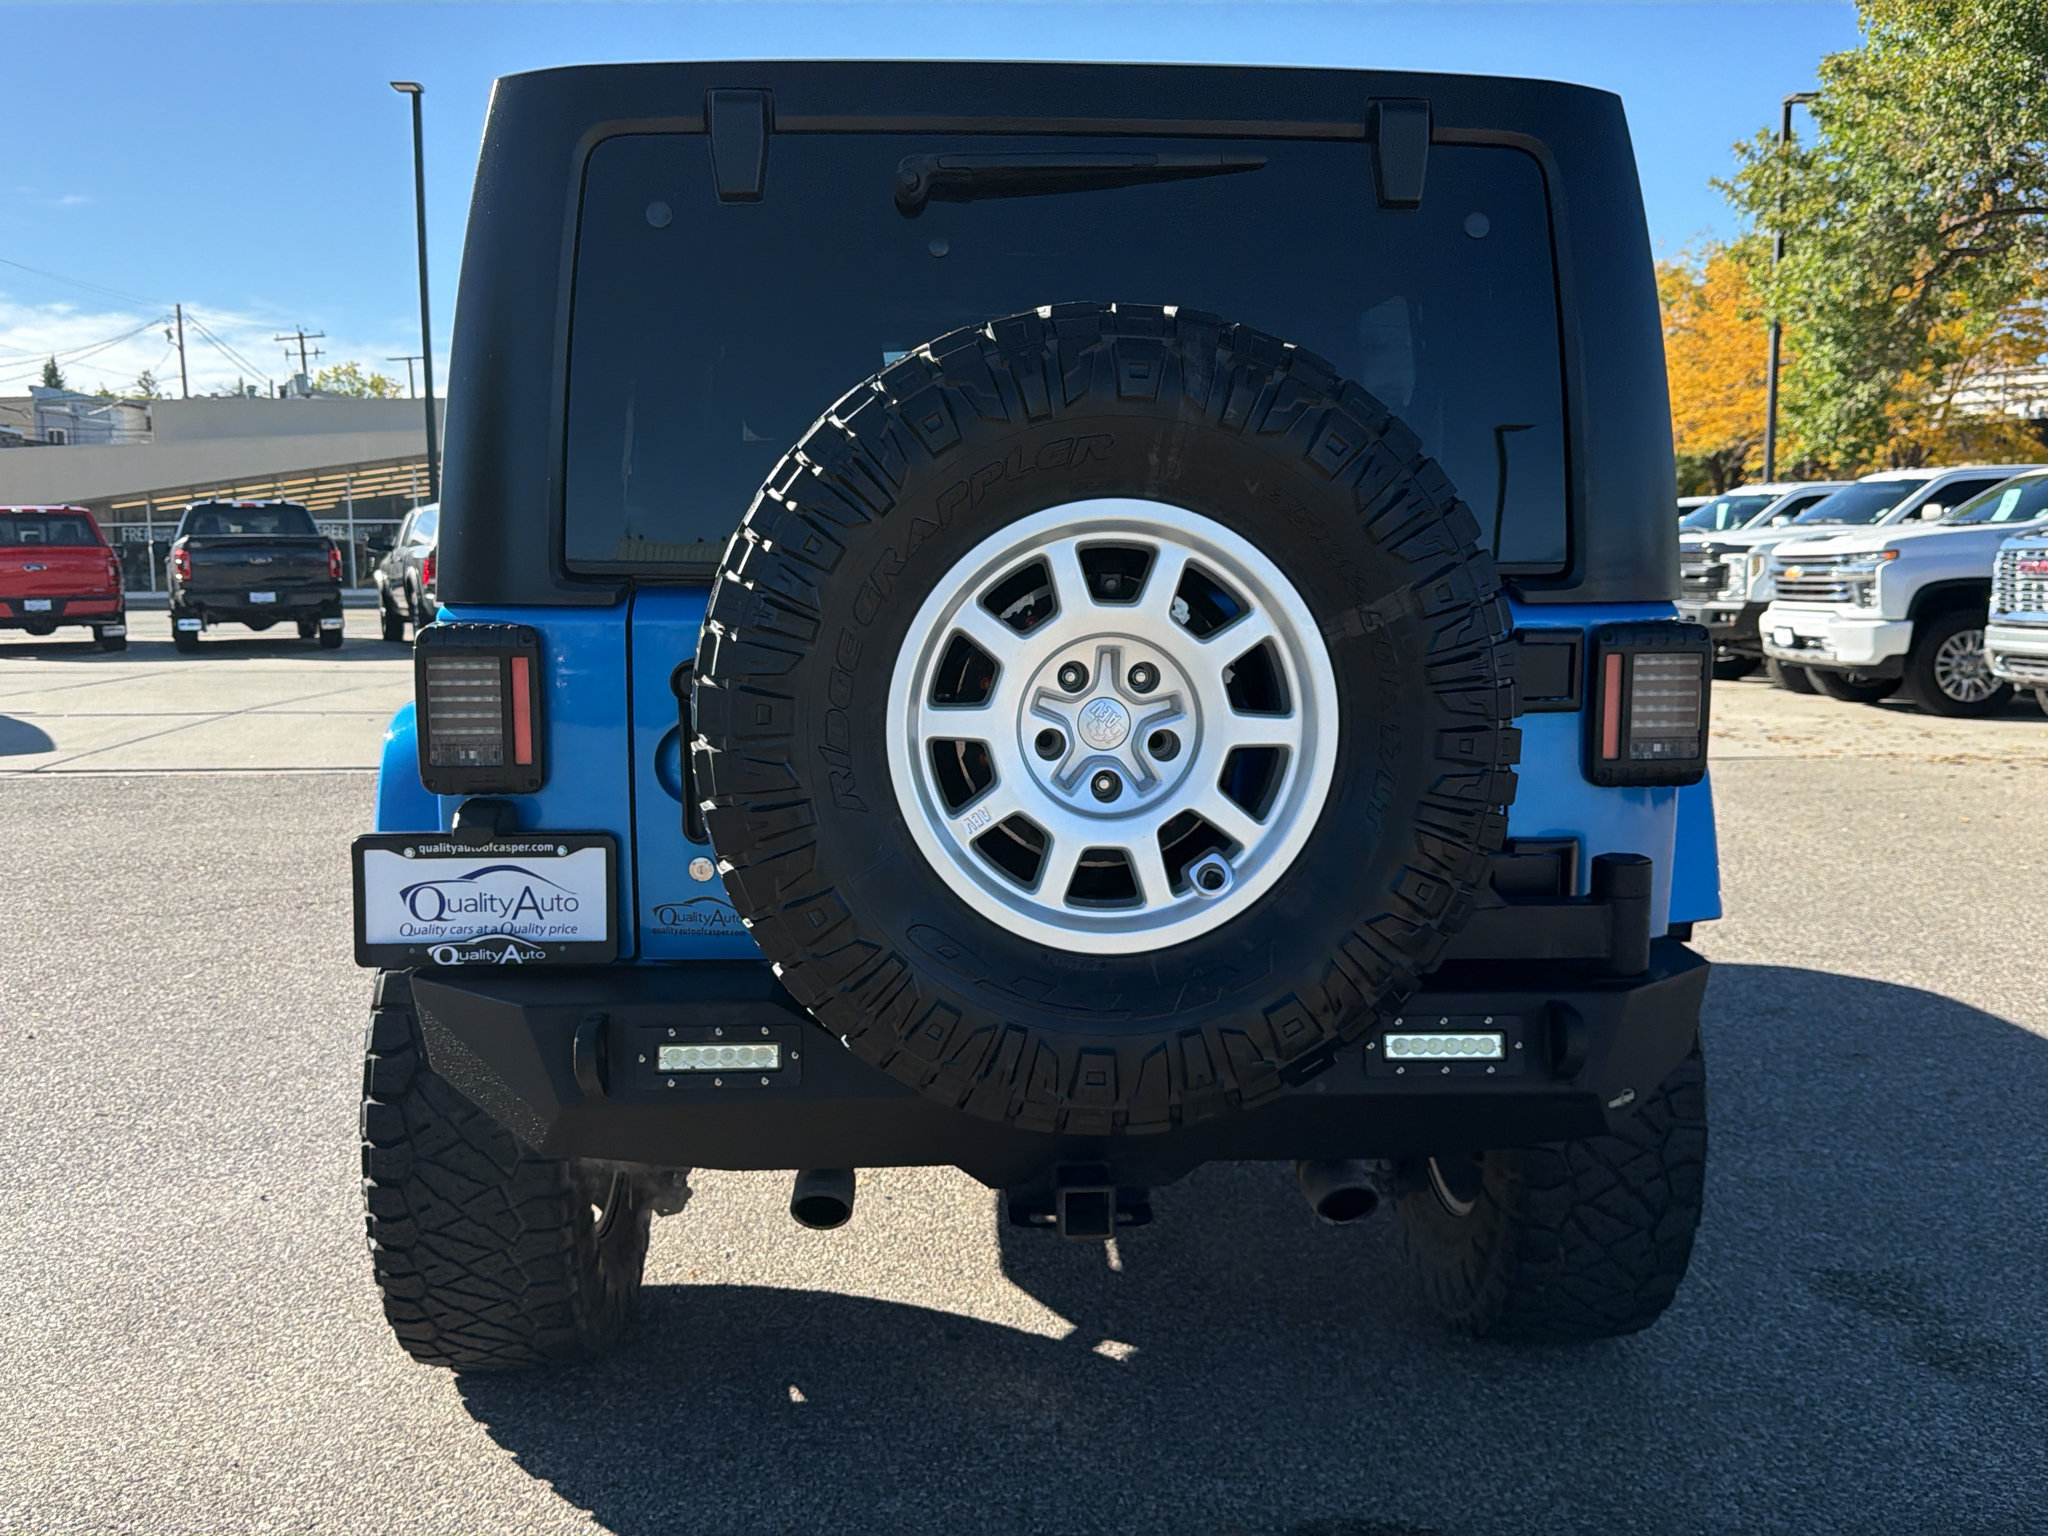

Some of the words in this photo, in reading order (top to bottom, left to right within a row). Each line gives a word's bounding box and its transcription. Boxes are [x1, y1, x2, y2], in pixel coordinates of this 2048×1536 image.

[853, 433, 1115, 625] GRAPPLER
[818, 628, 868, 813] RIDGE
[400, 923, 447, 937] Quality
[449, 925, 474, 935] cars
[548, 923, 578, 937] price
